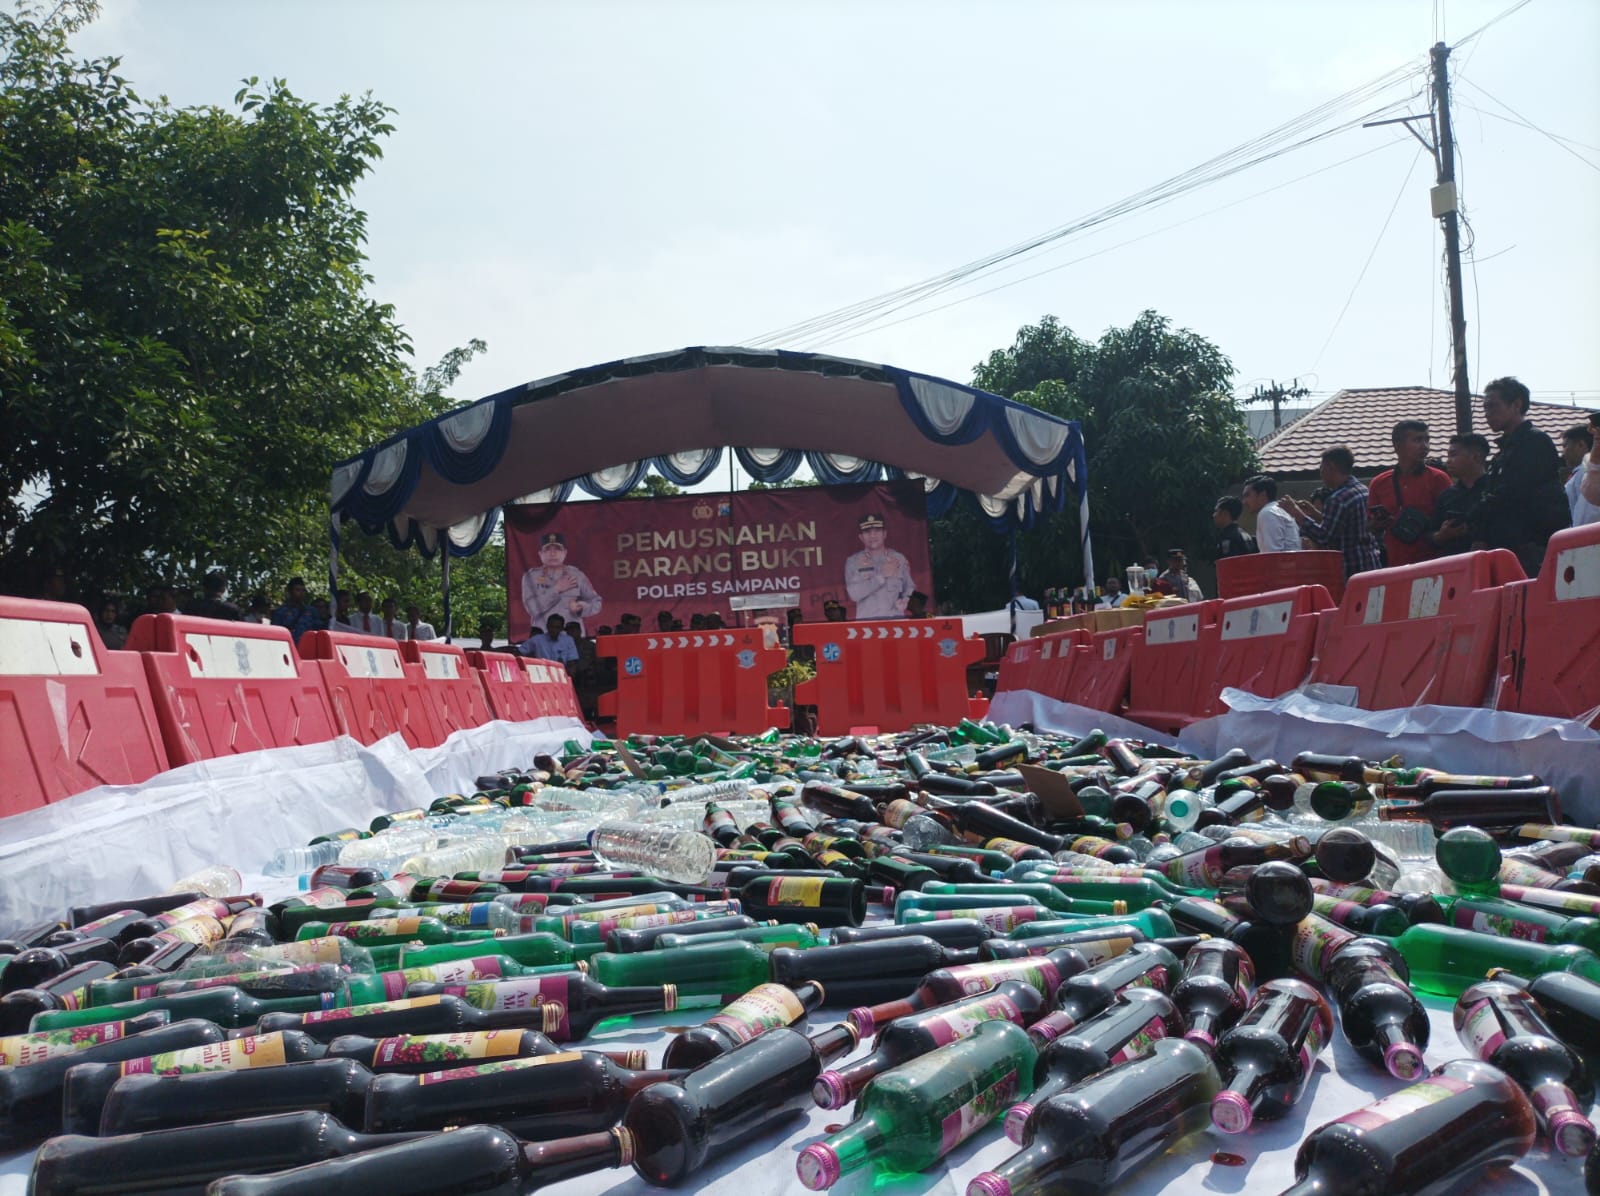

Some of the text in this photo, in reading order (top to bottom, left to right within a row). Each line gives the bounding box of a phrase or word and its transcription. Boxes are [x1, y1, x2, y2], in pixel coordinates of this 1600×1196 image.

[617, 521, 817, 552] PEMUSNAHAN
[613, 546, 823, 579] BARANG BUKTI
[637, 576, 801, 599] POLRES SAMPANG
